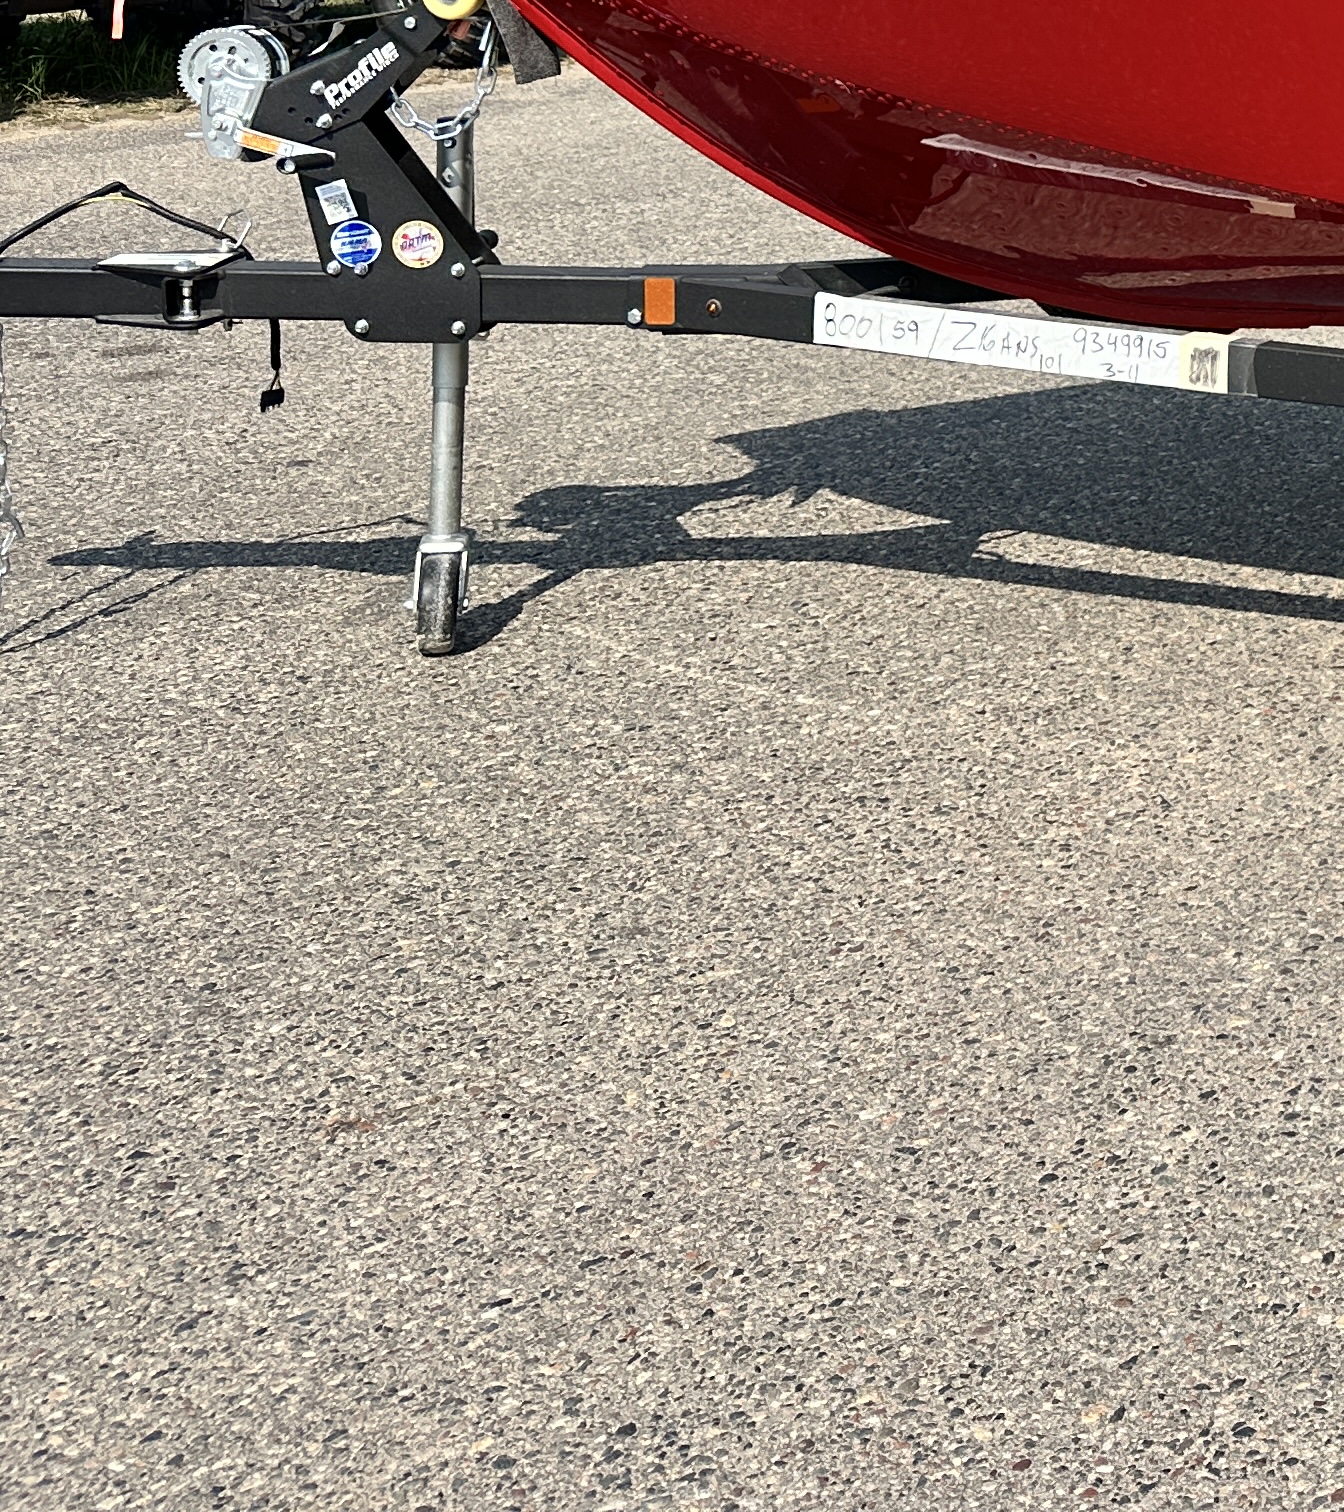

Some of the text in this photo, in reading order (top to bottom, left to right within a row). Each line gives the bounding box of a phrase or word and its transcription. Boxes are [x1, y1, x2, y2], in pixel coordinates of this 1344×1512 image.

[323, 41, 396, 109] Profile
[1072, 326, 1171, 359] 9349915
[1100, 362, 1139, 383] 3-11
